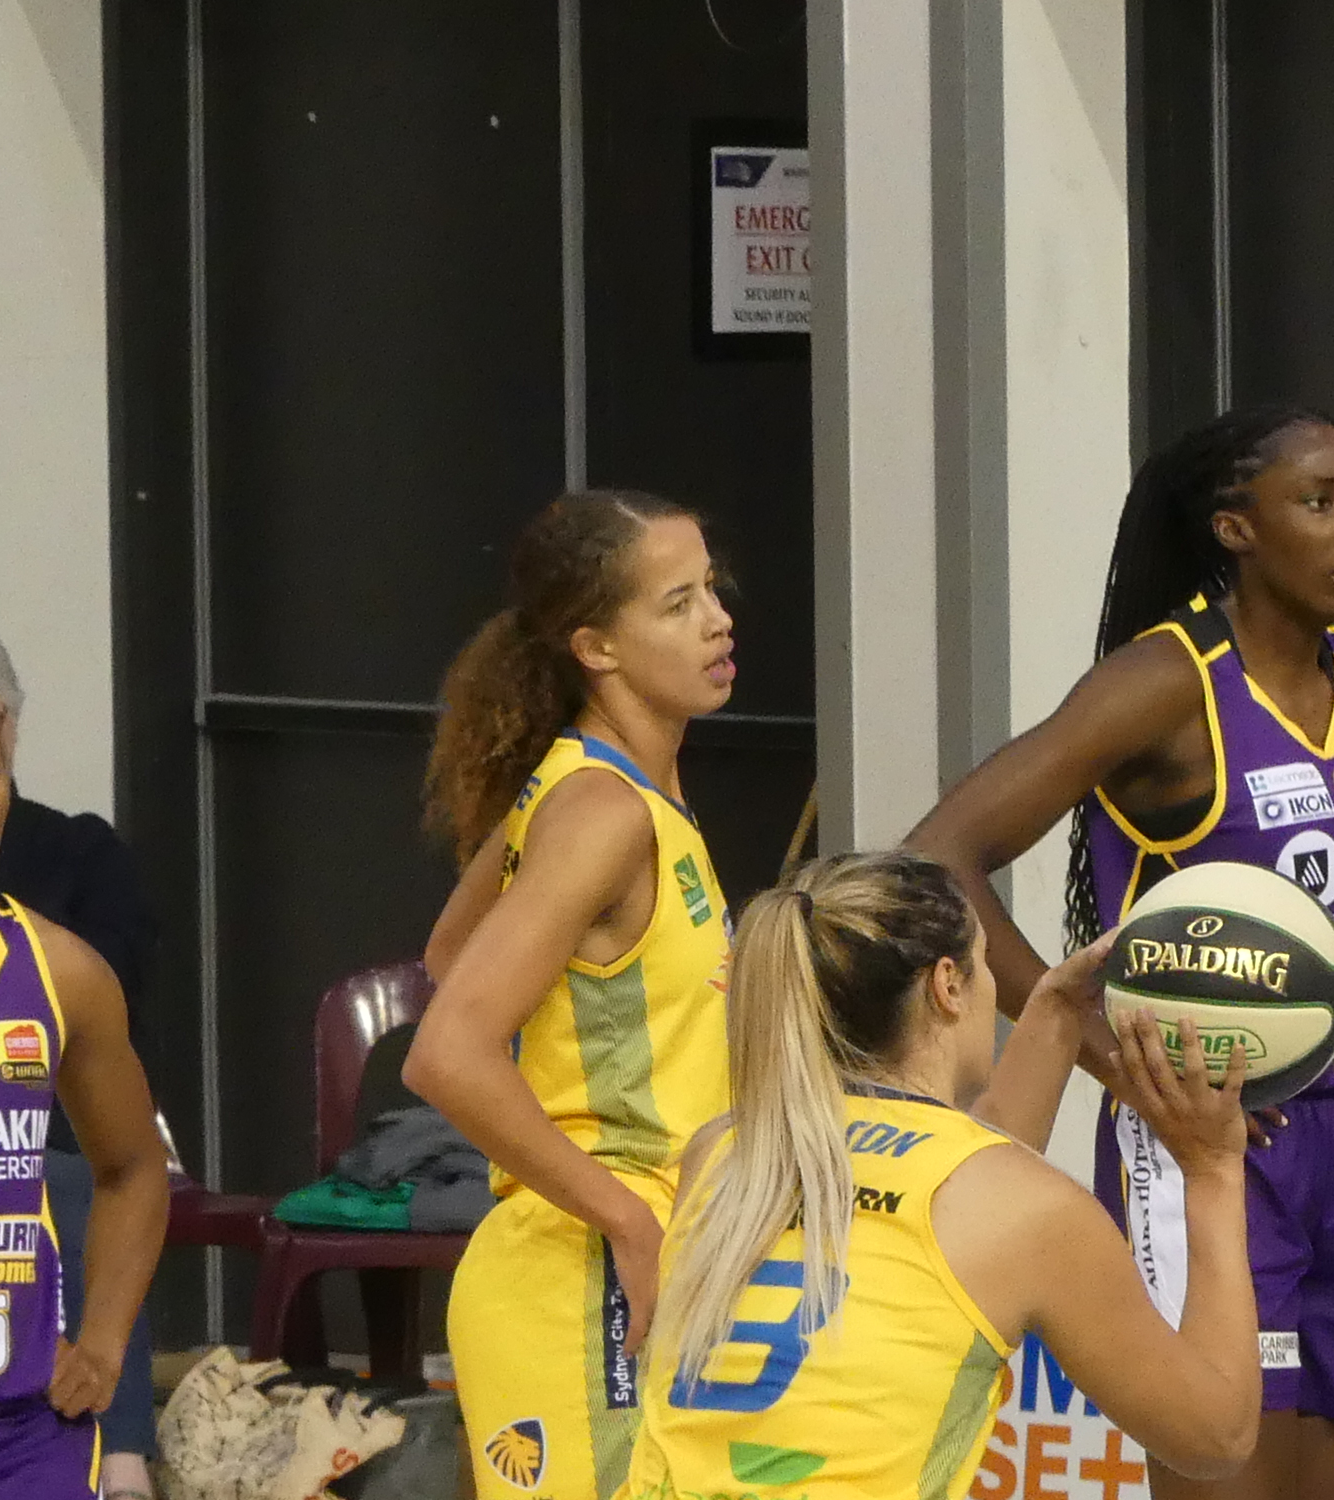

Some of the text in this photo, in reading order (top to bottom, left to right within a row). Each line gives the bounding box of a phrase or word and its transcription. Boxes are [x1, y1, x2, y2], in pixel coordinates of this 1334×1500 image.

[746, 245, 795, 271] EXIT
[1288, 793, 1333, 816] IKON
[1124, 938, 1290, 997] SPALDING
[668, 1259, 851, 1412] 3
[1261, 1351, 1288, 1364] PARK
